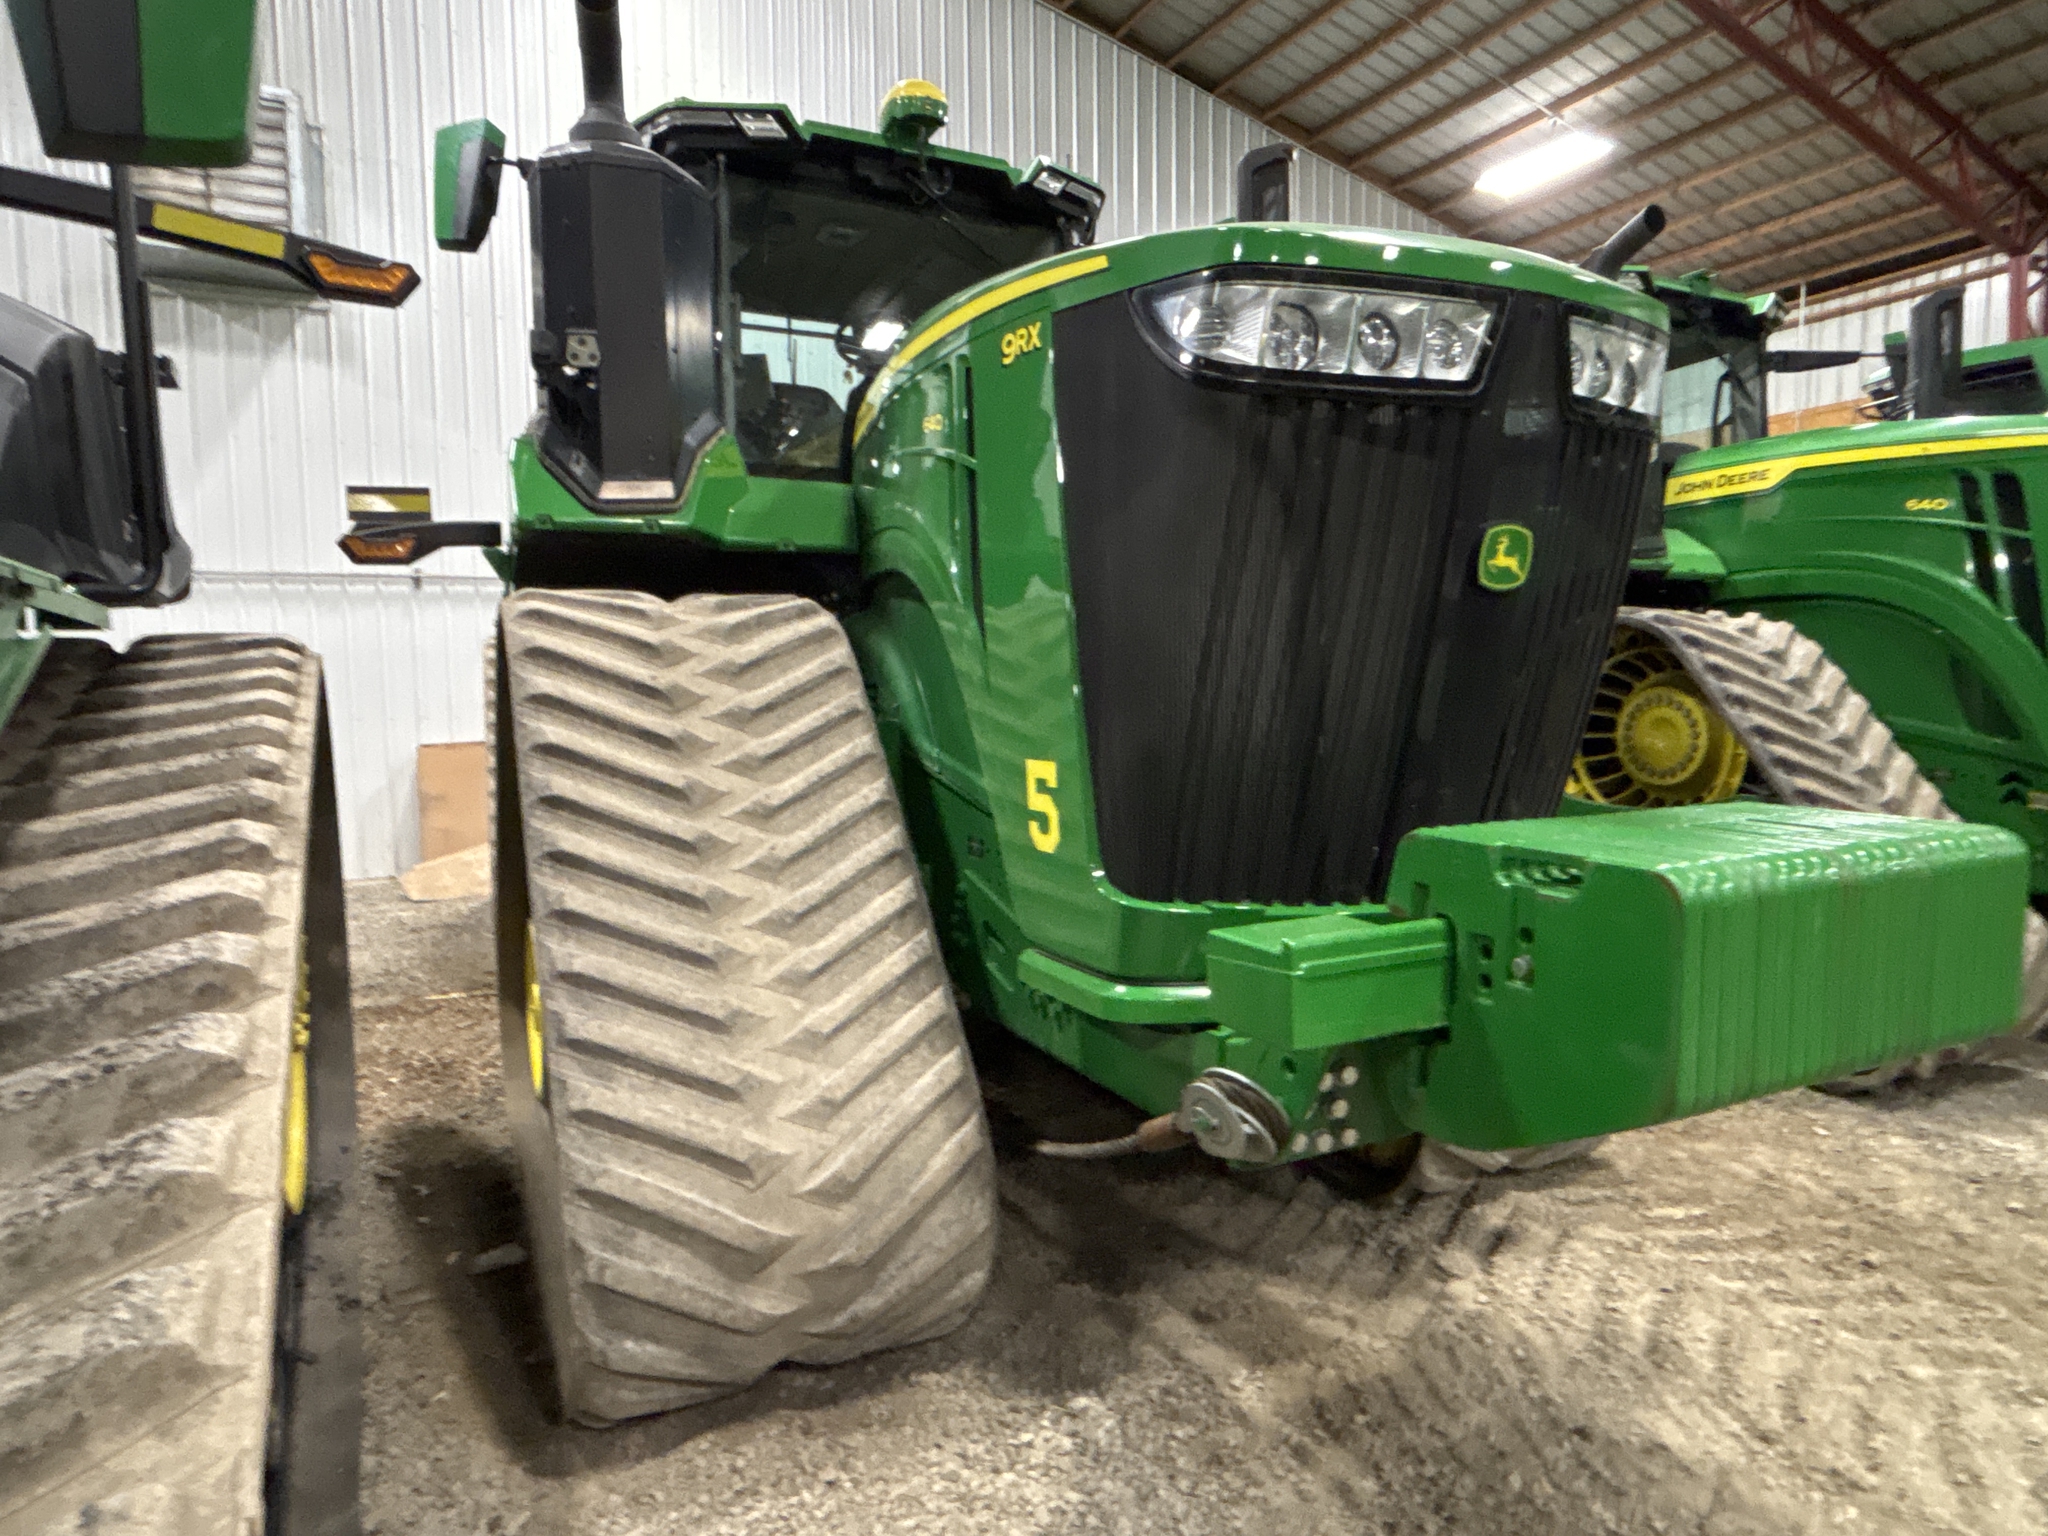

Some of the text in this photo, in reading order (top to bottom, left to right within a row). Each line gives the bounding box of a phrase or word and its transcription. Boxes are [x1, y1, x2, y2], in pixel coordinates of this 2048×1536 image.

[1001, 321, 1042, 365] 9RX
[1674, 468, 1771, 496] JOHN DEERE
[1905, 498, 1949, 511] 640
[1024, 758, 1061, 854] 5
